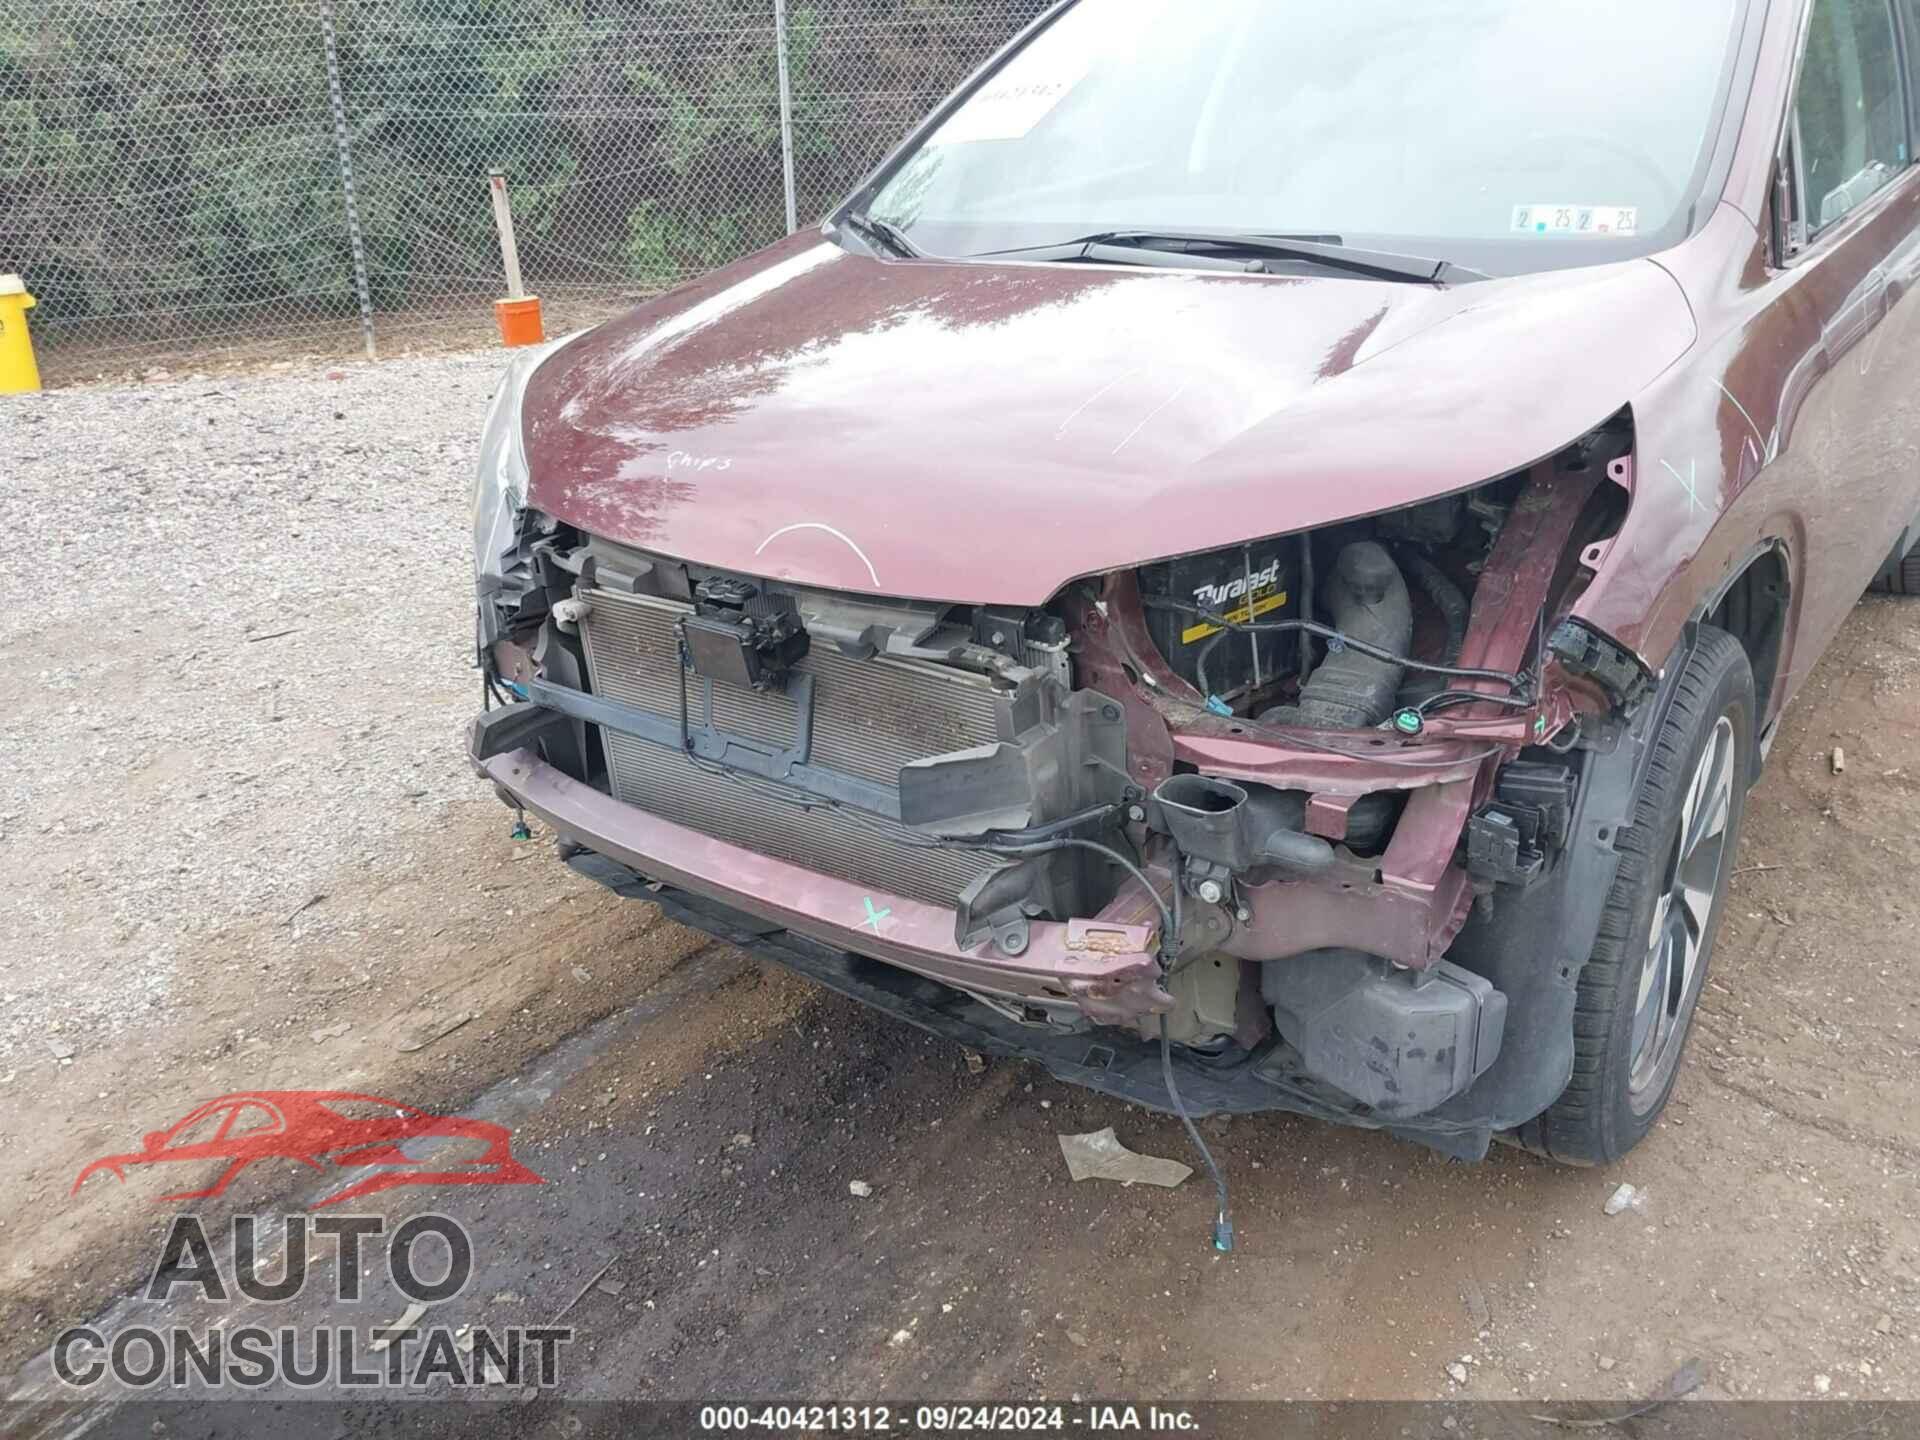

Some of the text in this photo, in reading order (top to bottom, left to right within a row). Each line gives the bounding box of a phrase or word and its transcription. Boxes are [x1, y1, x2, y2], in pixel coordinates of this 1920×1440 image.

[1518, 209, 1571, 229] 2 25
[1616, 211, 1634, 231] 25
